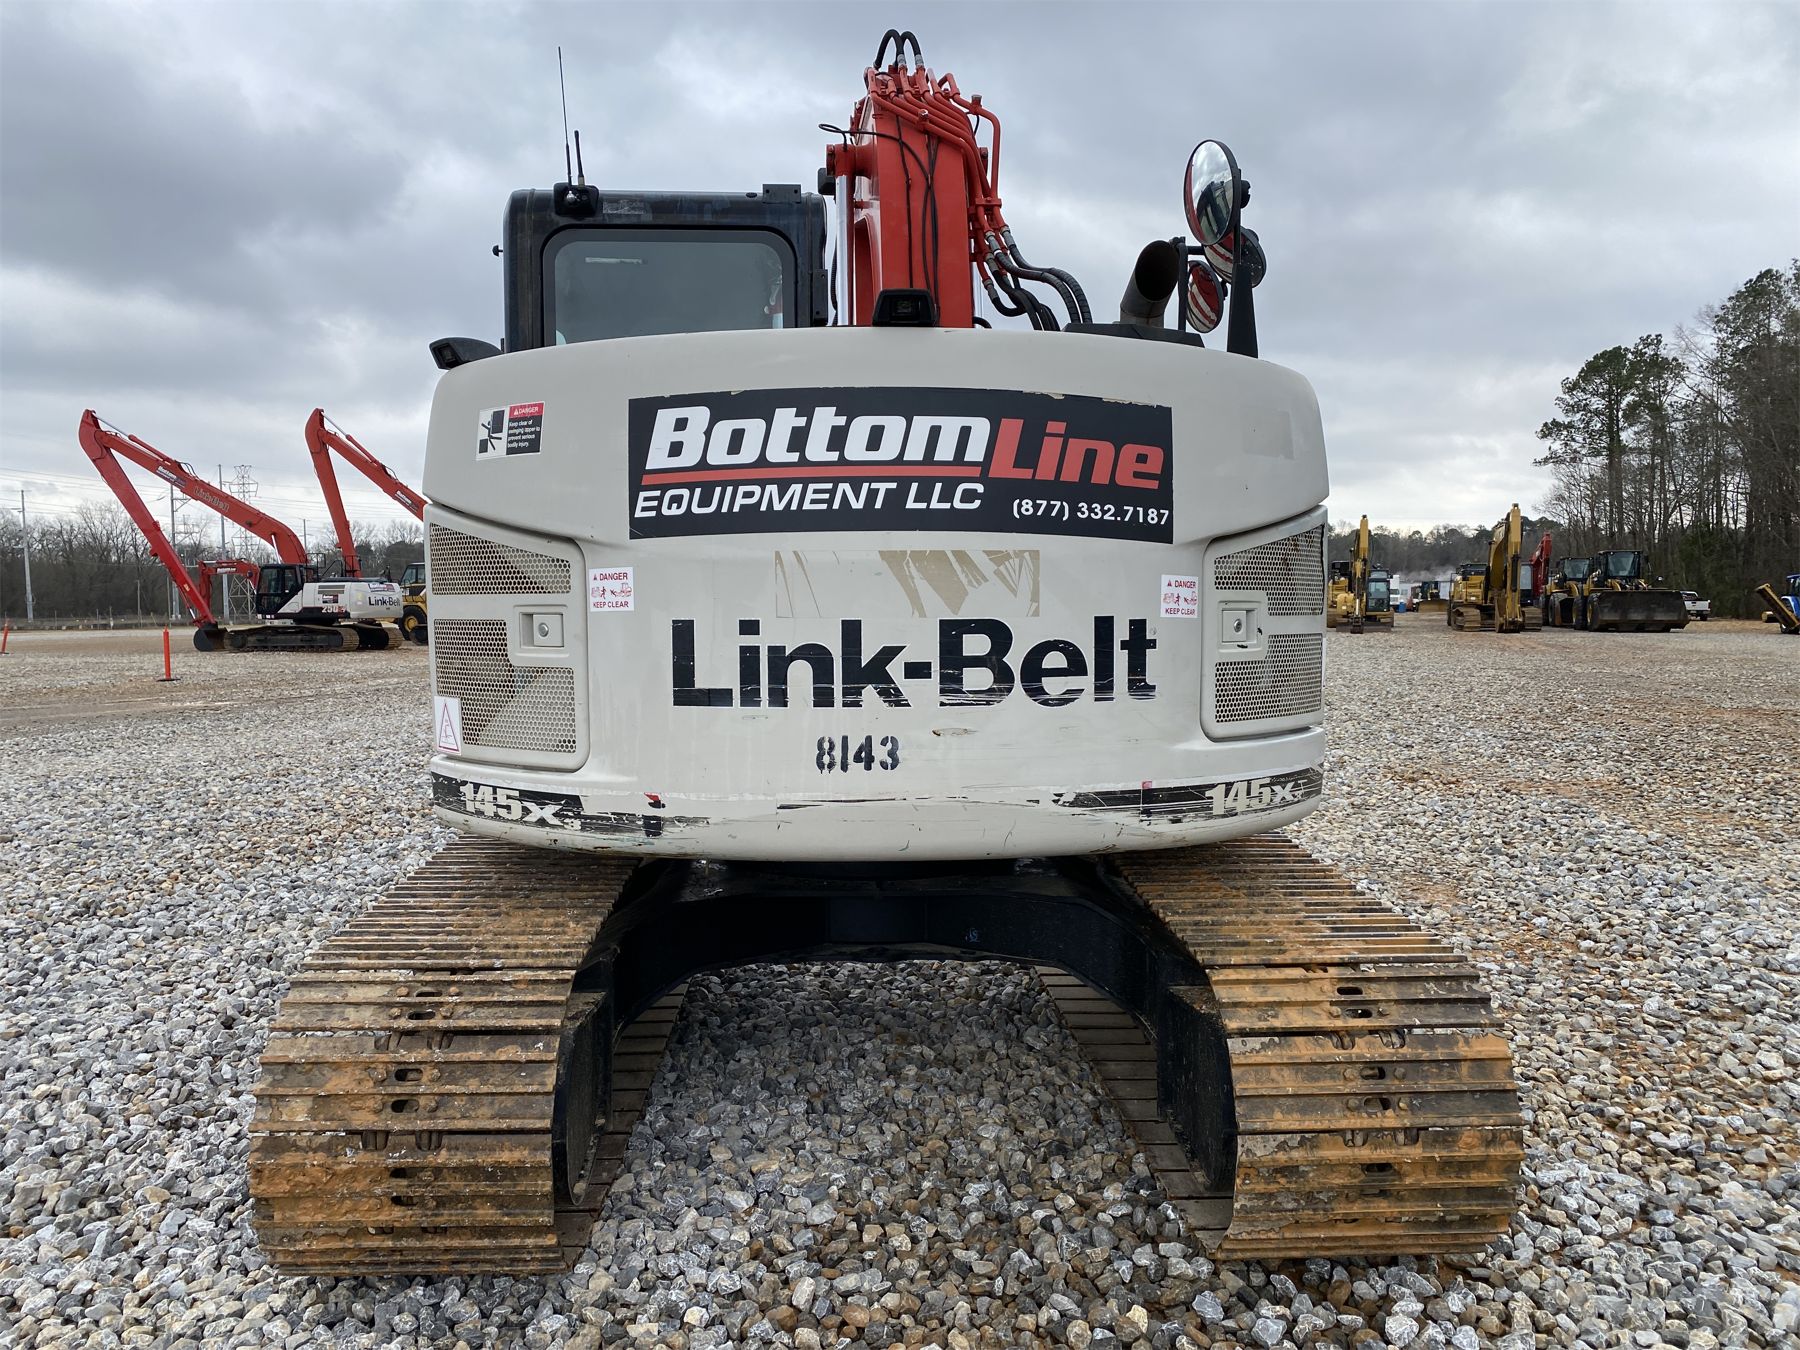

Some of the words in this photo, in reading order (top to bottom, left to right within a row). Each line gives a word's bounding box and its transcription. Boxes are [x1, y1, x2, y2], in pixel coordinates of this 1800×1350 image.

[634, 482, 899, 518] EQUIPMENT
[905, 482, 985, 510] LLC
[1013, 499, 1069, 521] (877)
[1076, 502, 1169, 525] 332.7187
[599, 572, 628, 581] DANGER
[1174, 580, 1196, 588] DANGER
[607, 600, 629, 608] CLEAR
[672, 615, 1158, 708] Link-Belt
[816, 735, 900, 773] 8143
